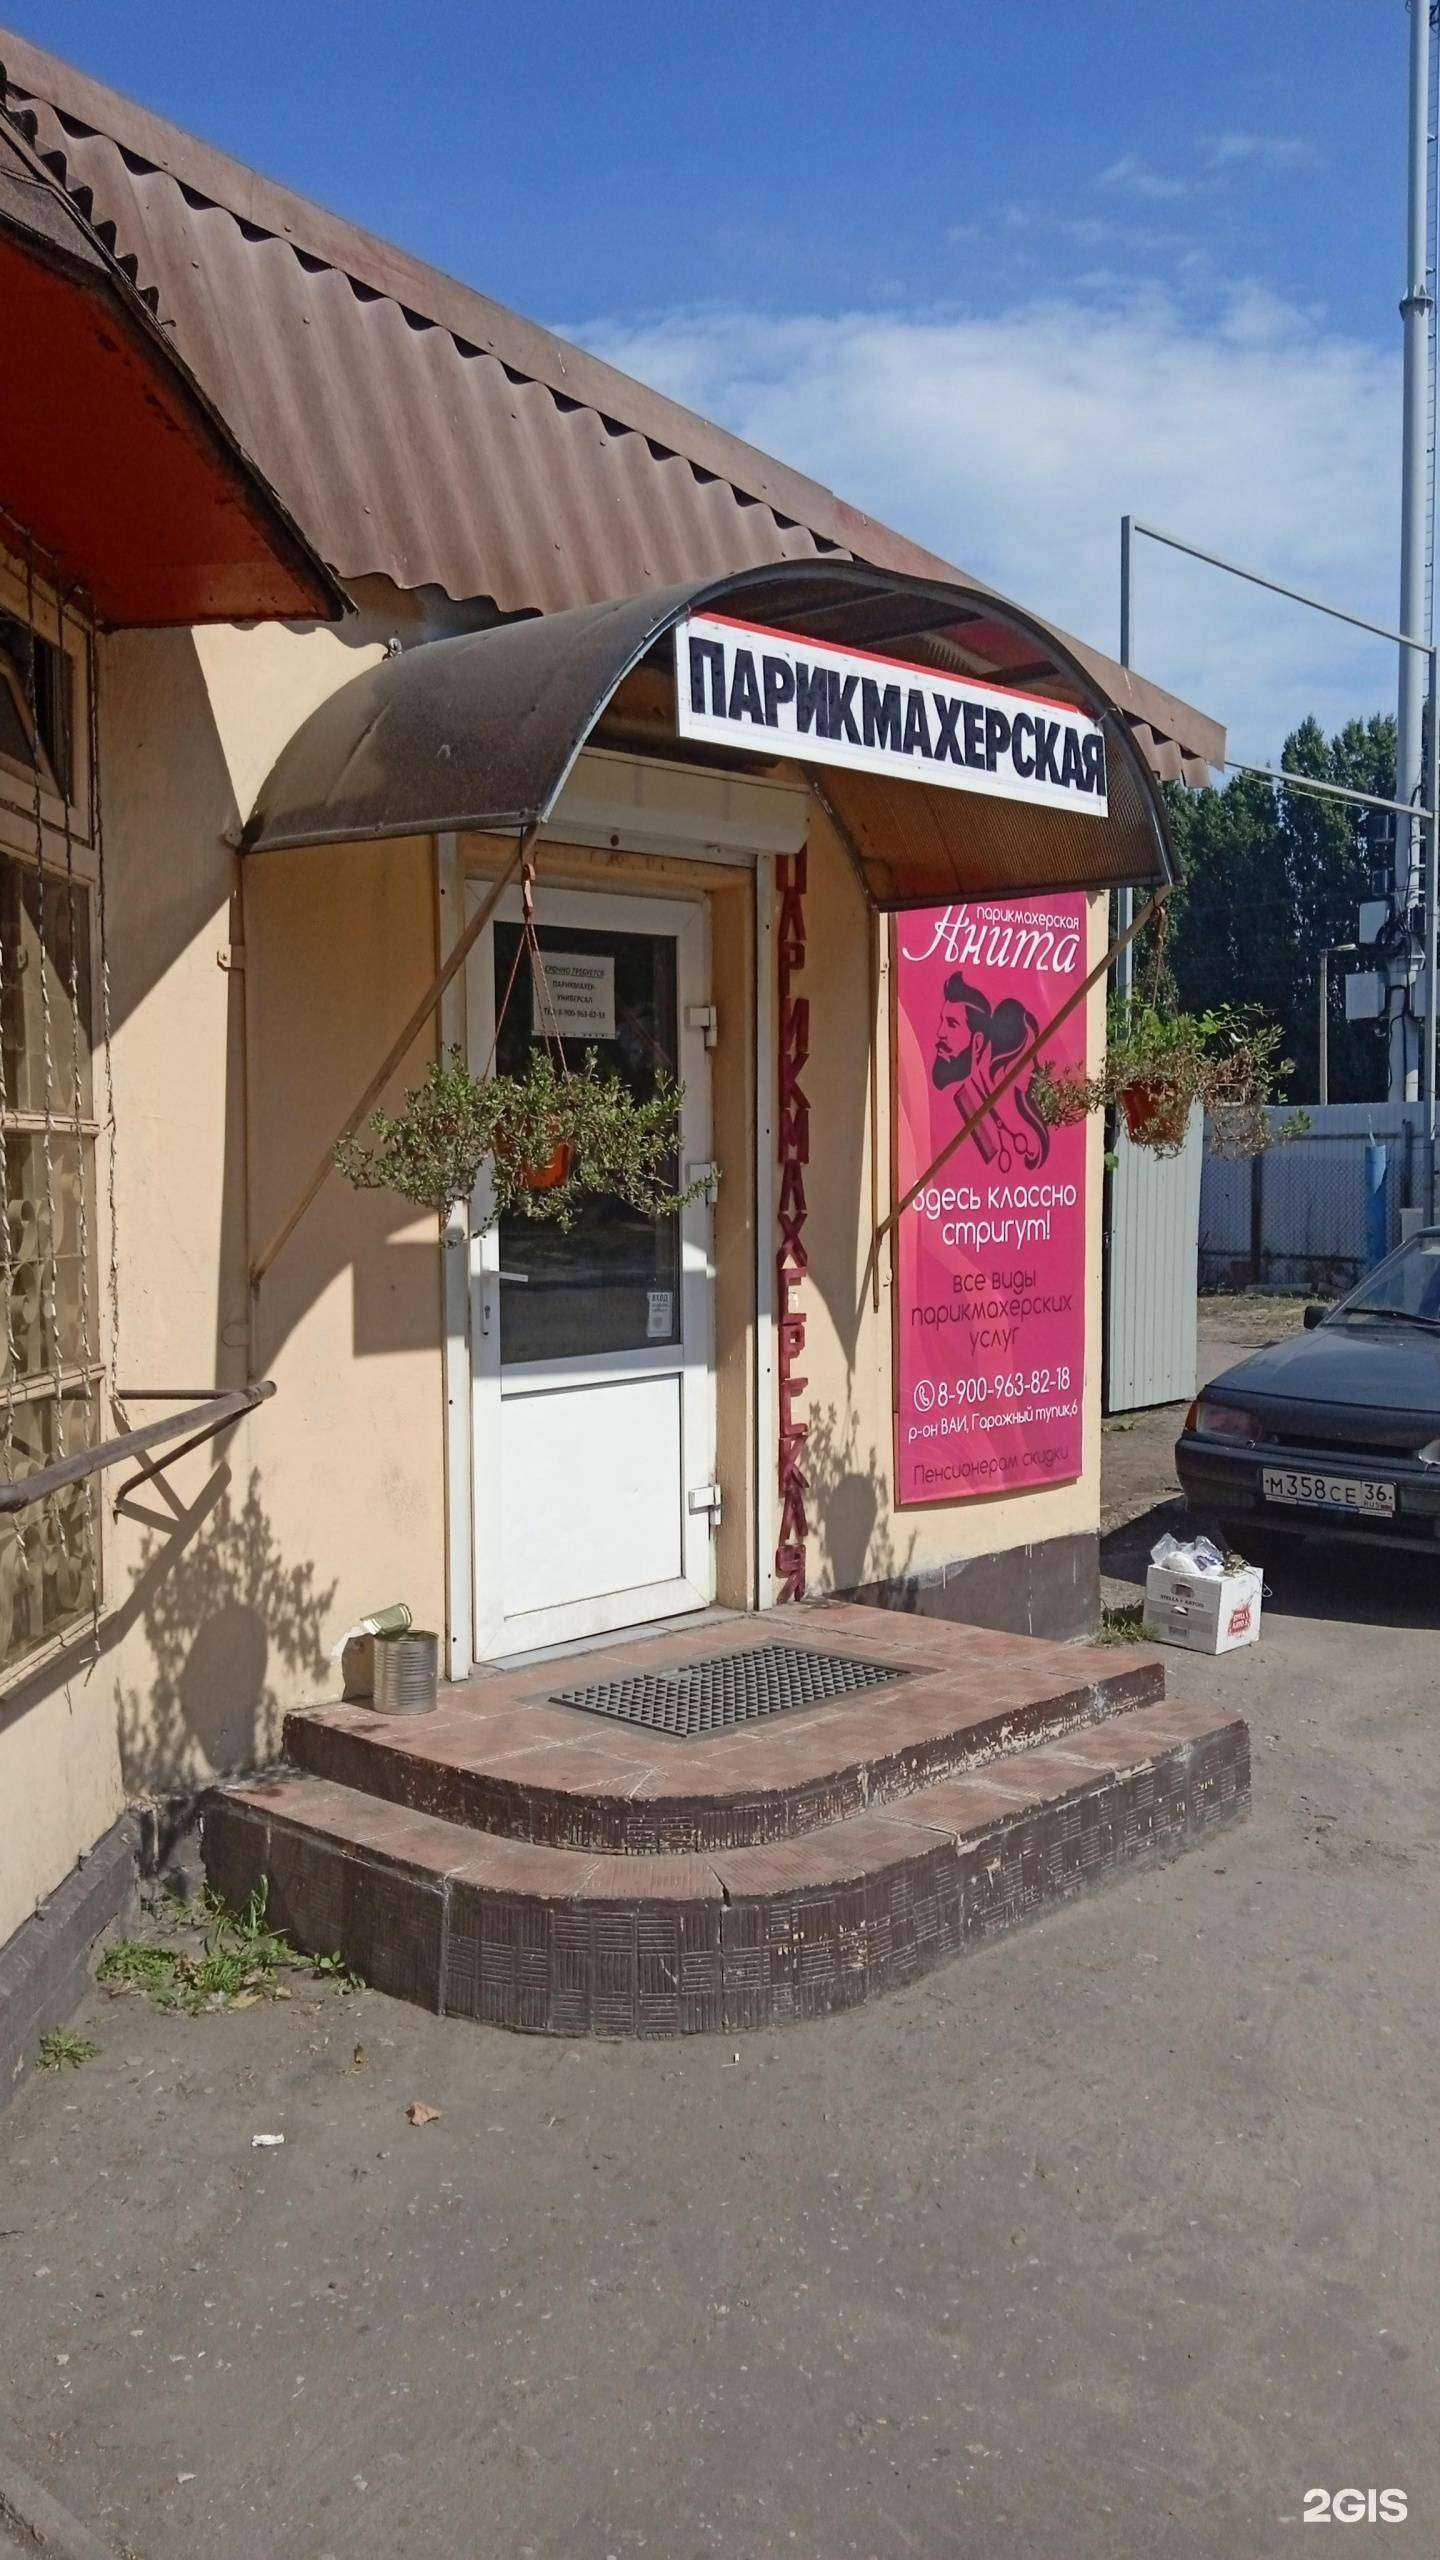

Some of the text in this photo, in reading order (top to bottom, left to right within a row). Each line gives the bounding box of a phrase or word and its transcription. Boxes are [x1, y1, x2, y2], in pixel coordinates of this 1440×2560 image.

[688, 636, 1107, 797] ПАРИКМАХЕРСКАЯ
[976, 905, 1080, 931] парикмахерская
[902, 903, 1081, 973] Анита
[988, 1184, 1077, 1210] классно
[942, 1210, 1051, 1253] стригут!
[991, 1269, 1036, 1296] виды
[911, 1294, 1073, 1332] парикмахерских
[969, 1326, 1020, 1357] услуг
[937, 1366, 1071, 1407] 8-900-963-82-18
[908, 1425, 938, 1444] р-он
[971, 1406, 1034, 1432] Гаражный
[913, 1446, 1070, 1486] Пенсионерам скидки
[1270, 1474, 1387, 1505] М358СЕ 36
